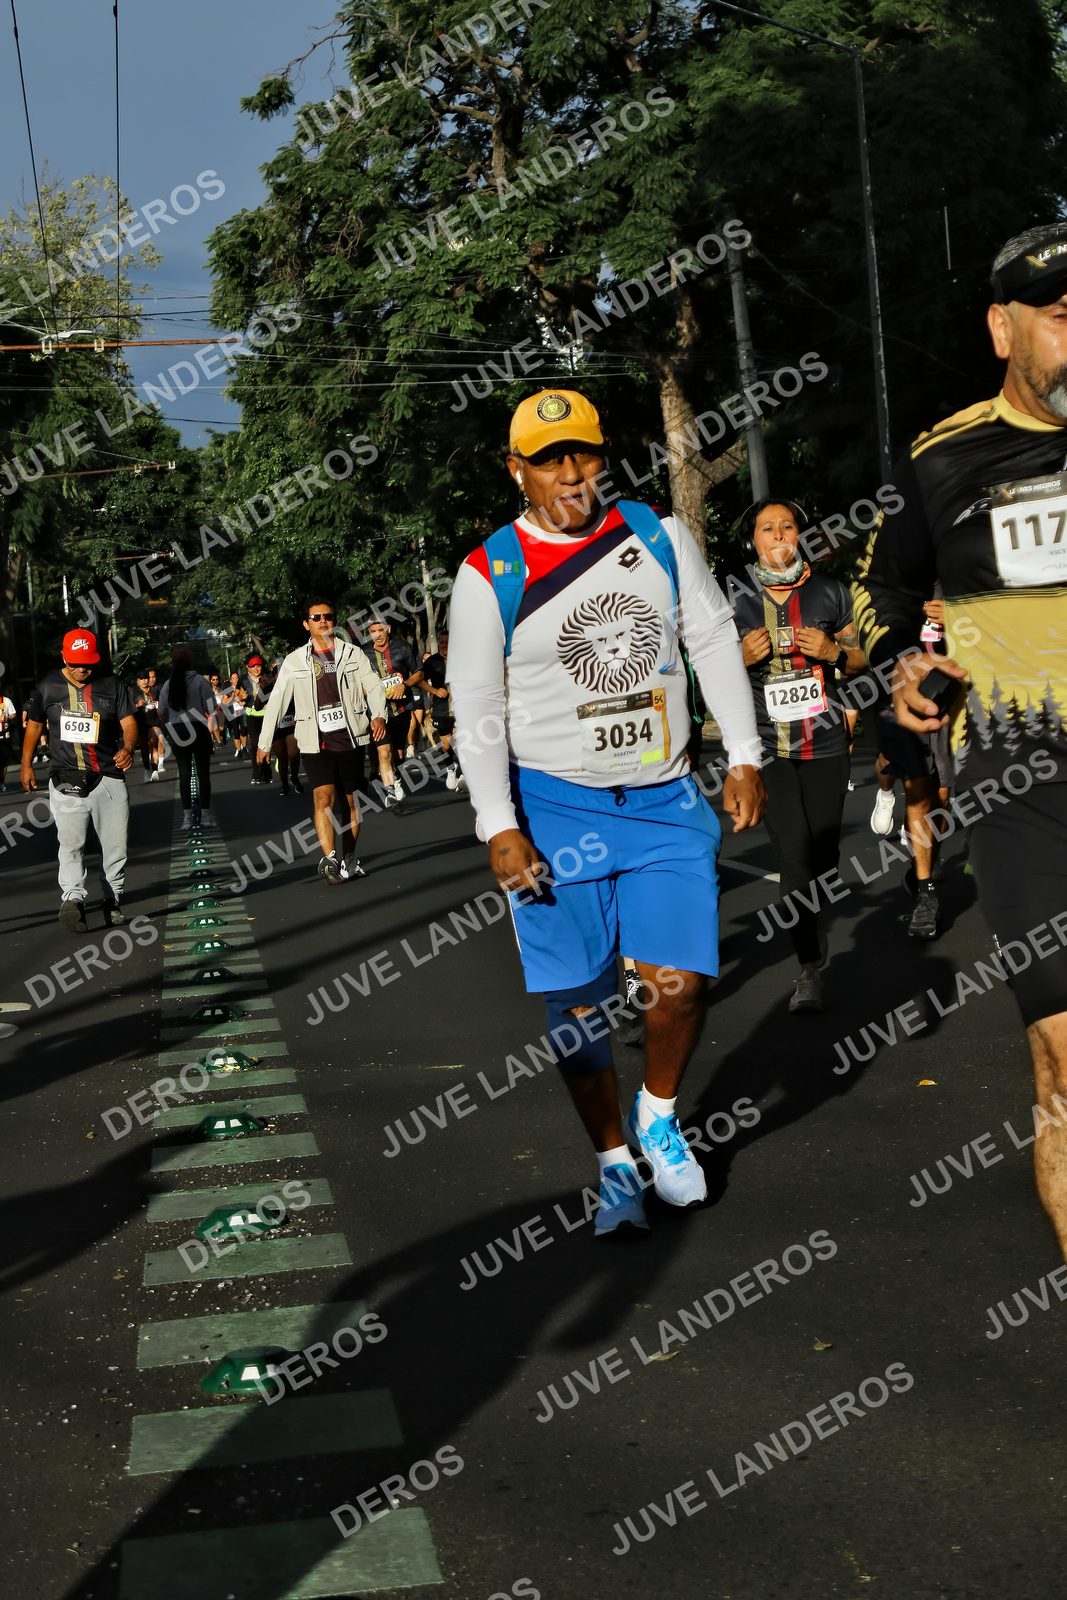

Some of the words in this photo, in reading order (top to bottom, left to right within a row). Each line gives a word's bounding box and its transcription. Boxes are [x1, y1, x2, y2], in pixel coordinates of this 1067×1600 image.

[1033, 480, 1061, 490] NEGROS
[654, 696, 664, 704] 5K
[768, 682, 819, 706] 12826
[322, 710, 344, 722] 5183
[64, 720, 90, 733] 6503
[594, 718, 654, 752] 3034
